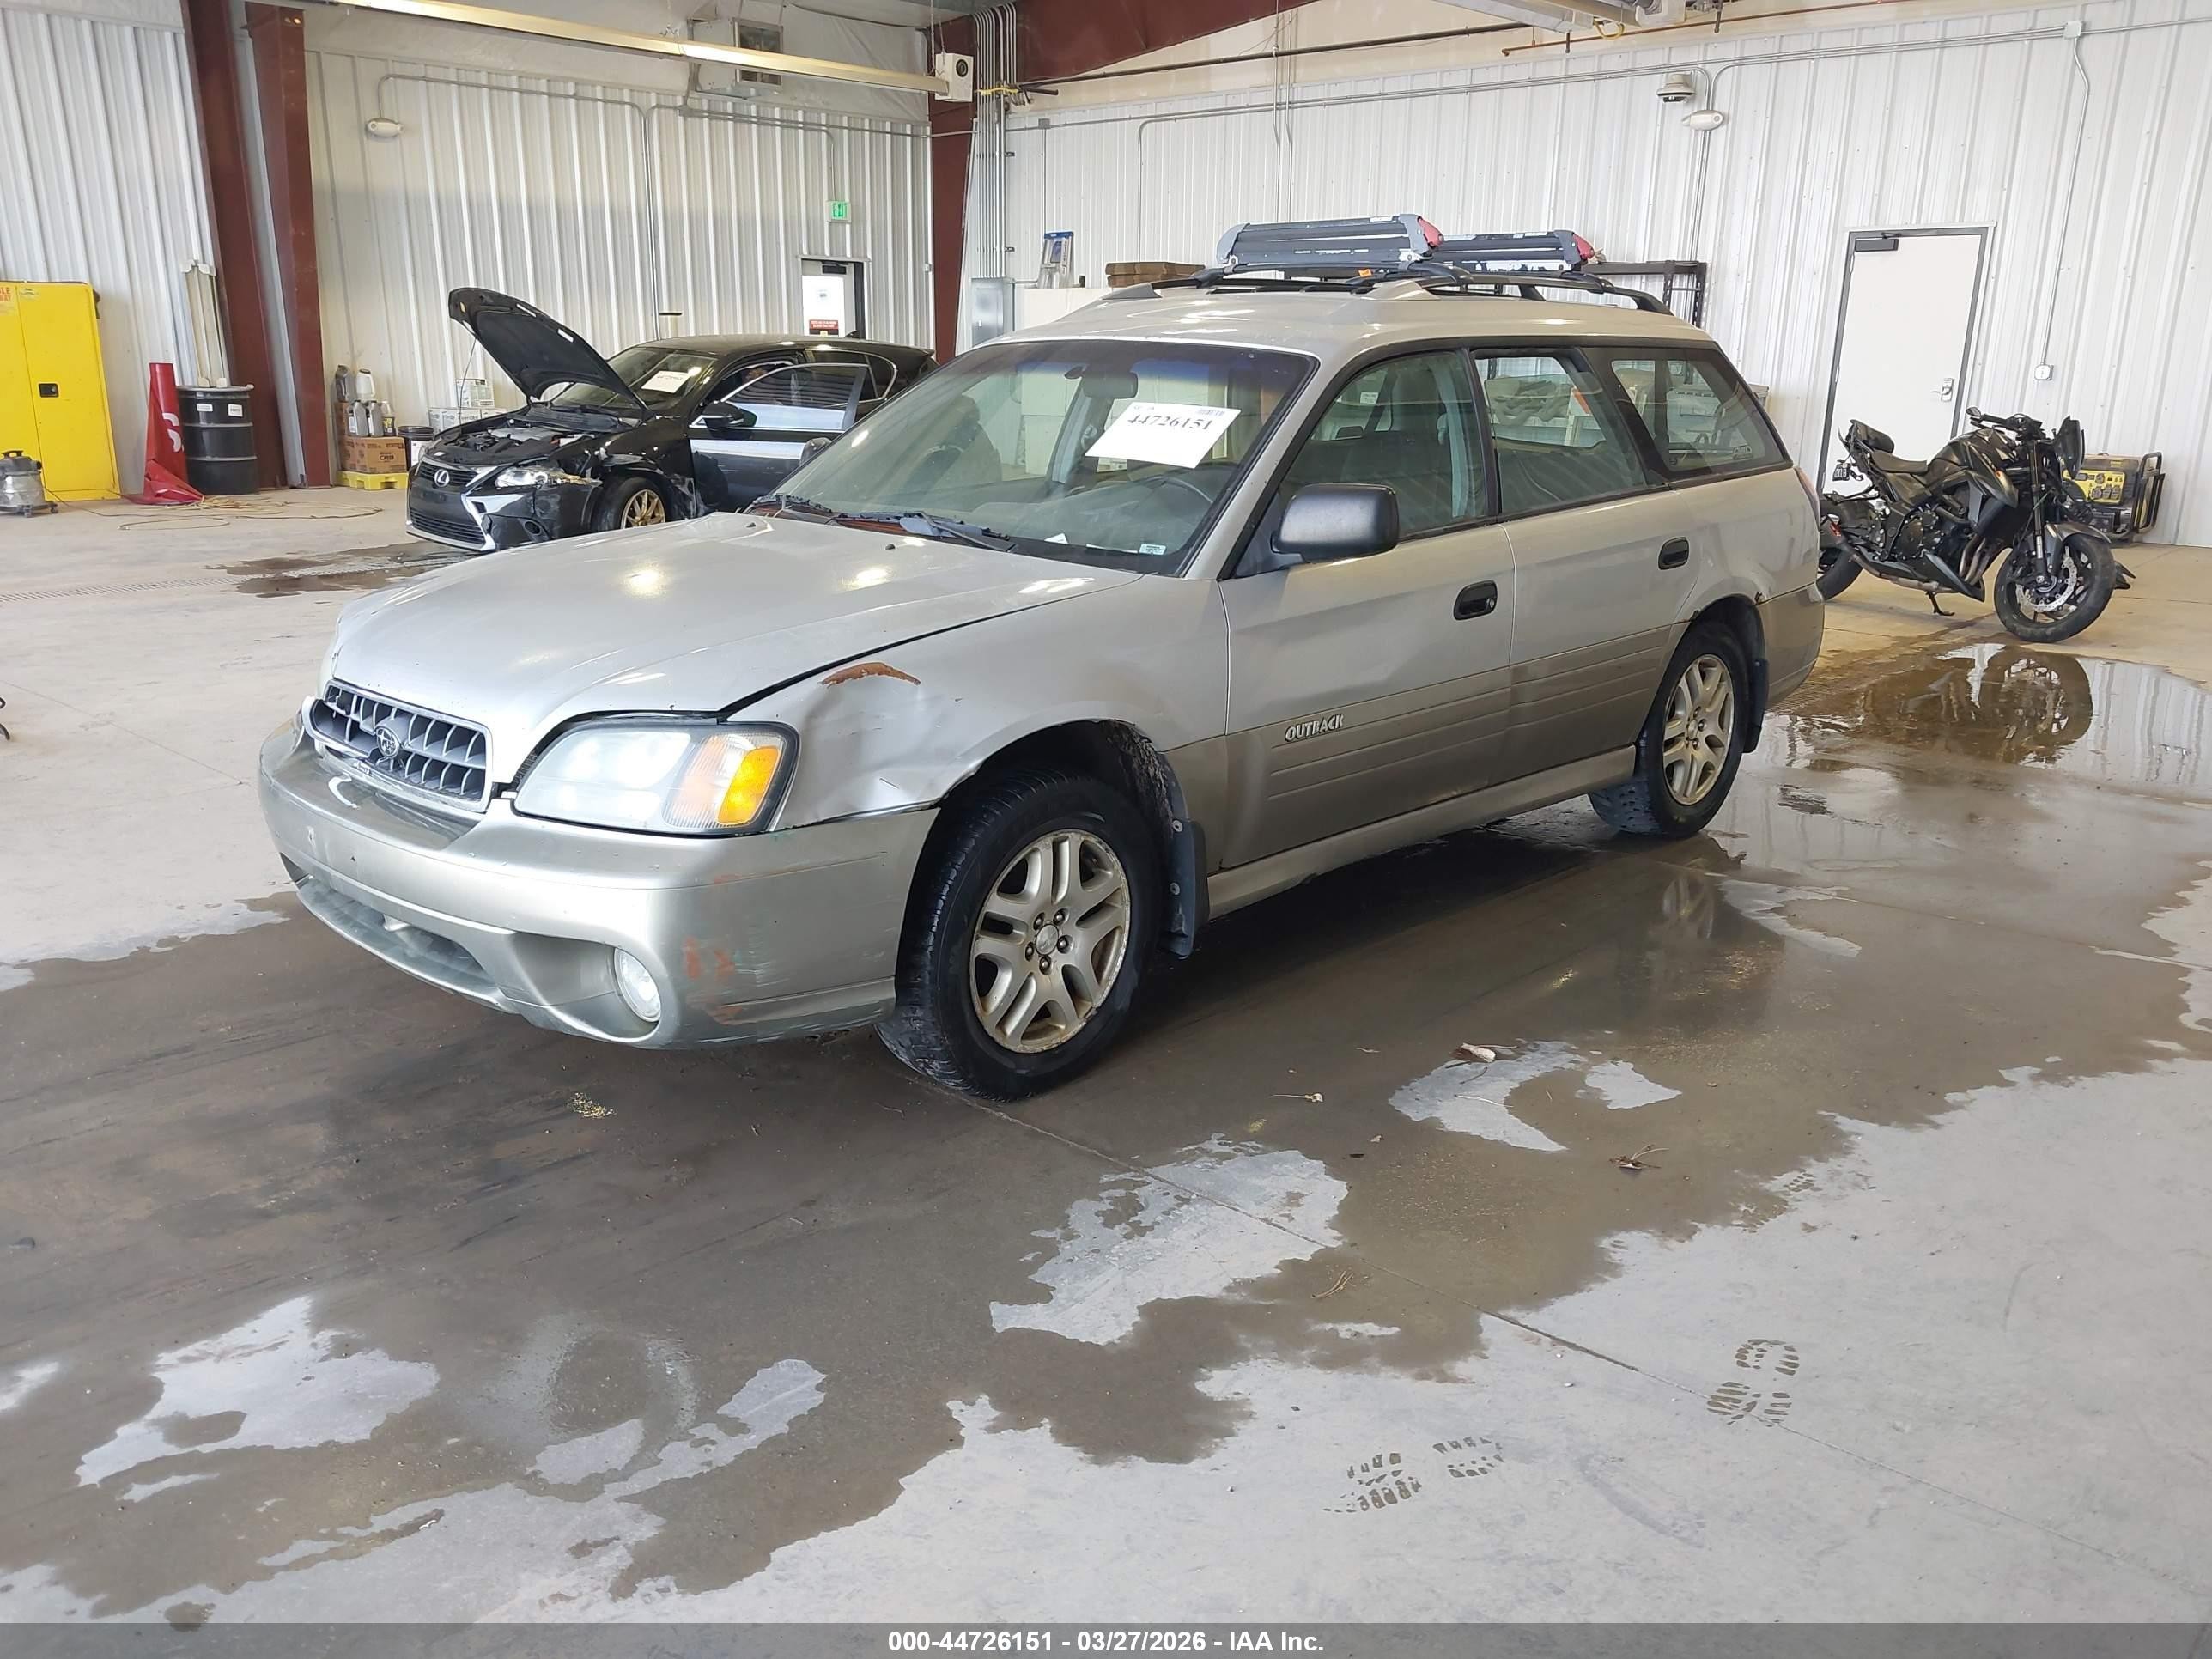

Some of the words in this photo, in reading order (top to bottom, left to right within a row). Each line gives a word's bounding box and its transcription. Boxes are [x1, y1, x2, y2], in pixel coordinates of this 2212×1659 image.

[833, 203, 848, 217] EXIT
[1127, 414, 1213, 430] 44726151
[1285, 714, 1344, 742] OUTBACK
